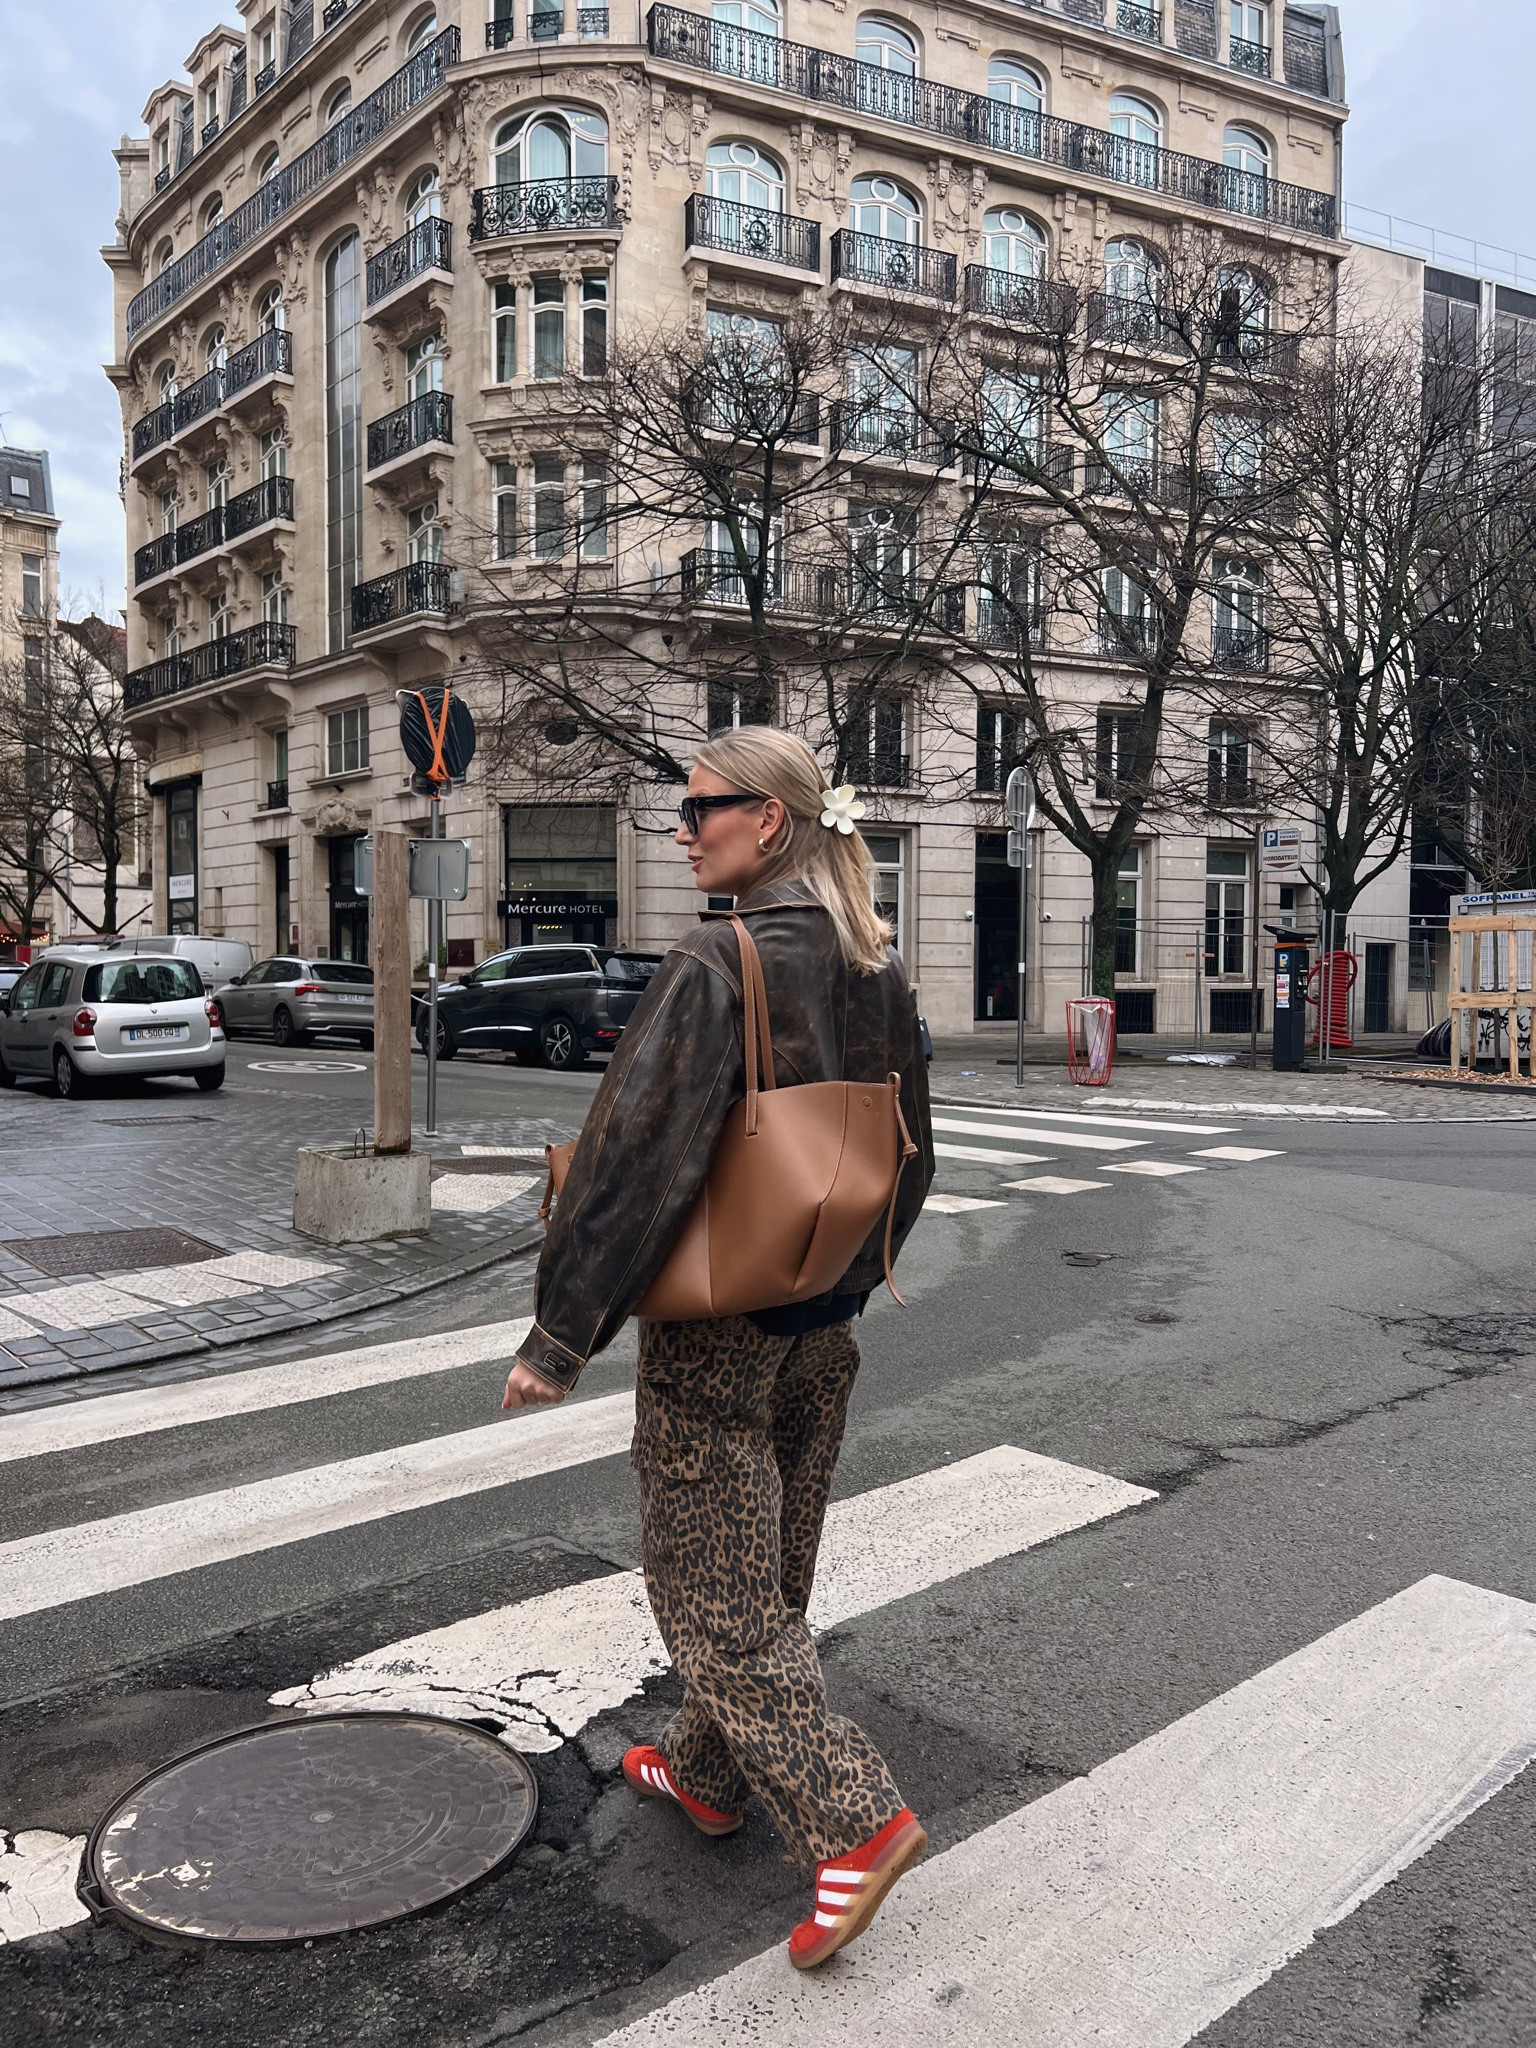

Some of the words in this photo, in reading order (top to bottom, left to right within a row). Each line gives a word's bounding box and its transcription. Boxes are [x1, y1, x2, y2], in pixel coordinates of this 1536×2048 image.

[1266, 832, 1276, 846] P
[1462, 893, 1526, 903] SOFRANEL
[508, 904, 567, 914] Mercure
[569, 905, 605, 914] HOTEL
